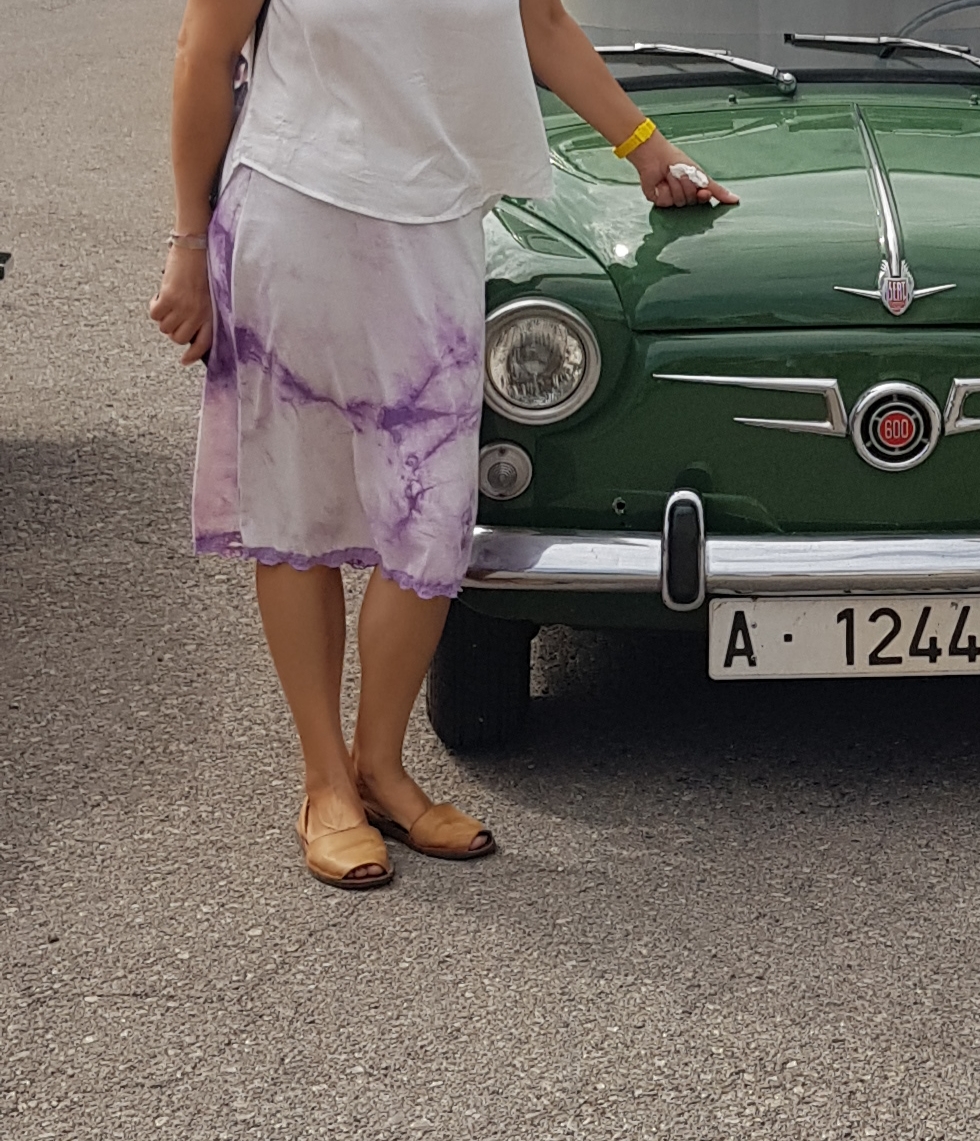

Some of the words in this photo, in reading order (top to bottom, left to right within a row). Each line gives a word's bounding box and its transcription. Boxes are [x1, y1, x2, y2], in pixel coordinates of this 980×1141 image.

[887, 280, 908, 302] SEAT
[884, 418, 909, 440] 600
[723, 610, 757, 668] A
